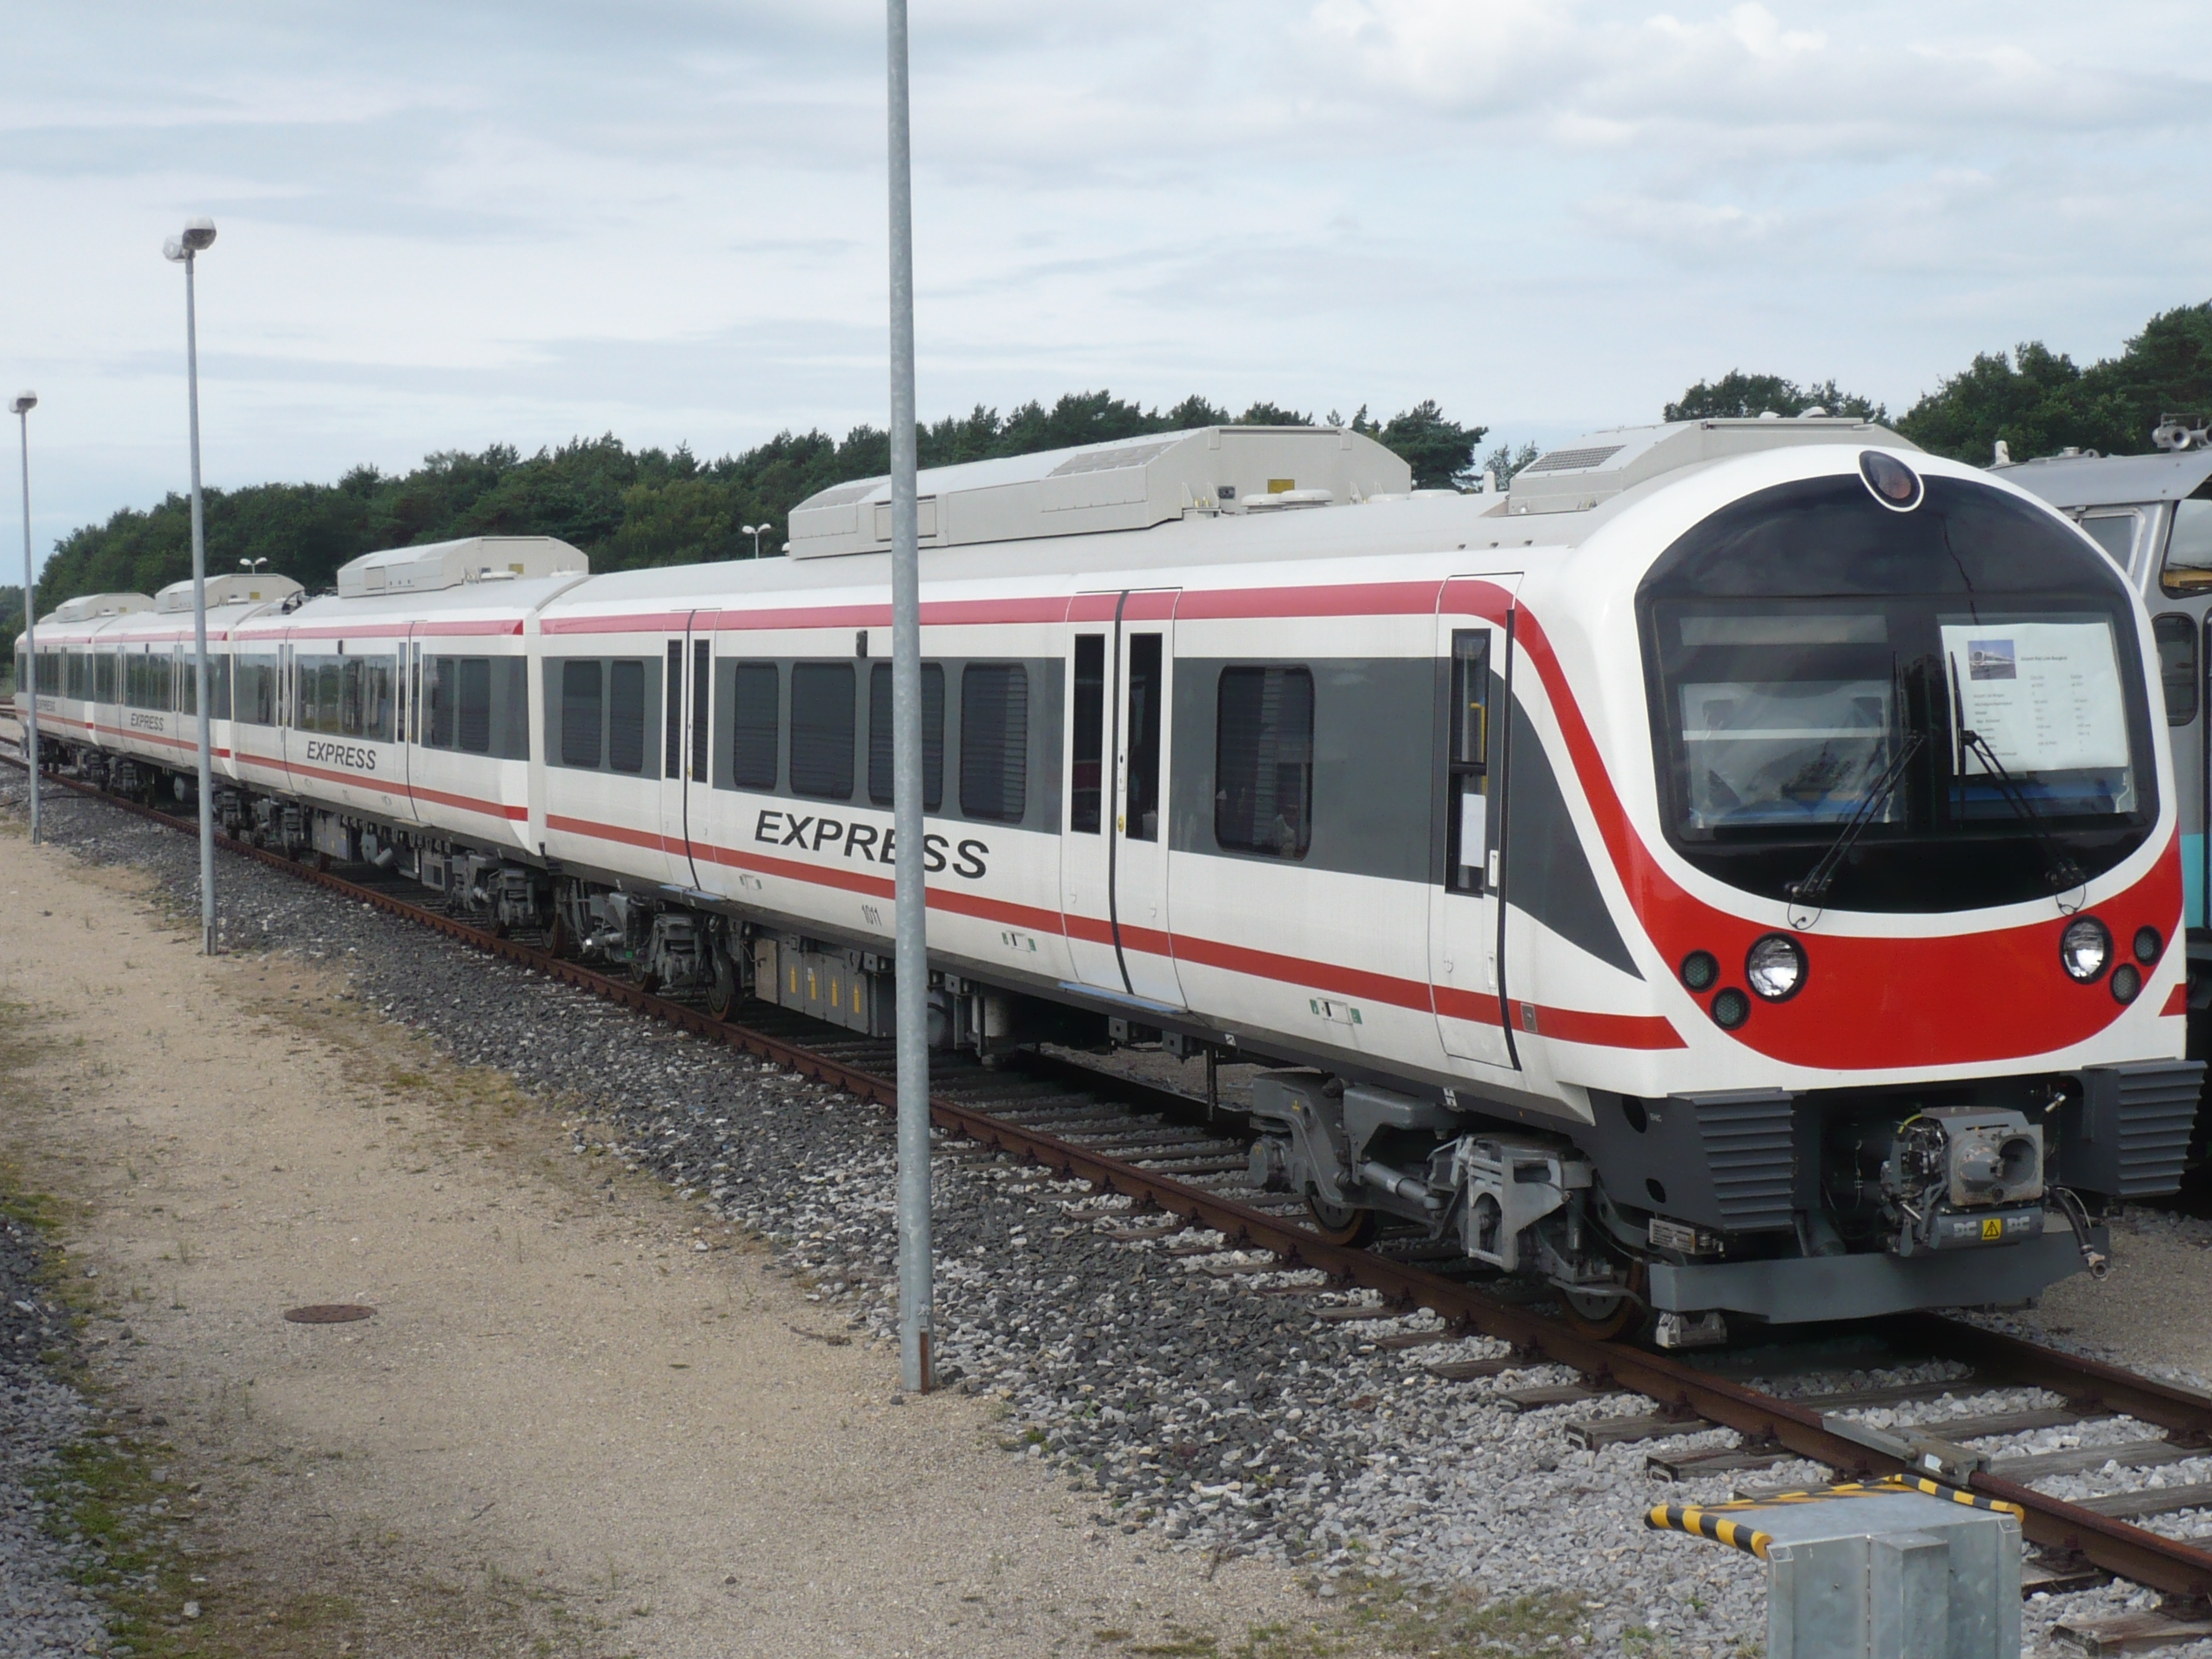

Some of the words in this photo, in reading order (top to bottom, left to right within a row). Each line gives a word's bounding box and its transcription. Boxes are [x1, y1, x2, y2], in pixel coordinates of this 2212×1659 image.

[131, 712, 164, 732] EXPRESS
[307, 740, 376, 771] EXPRESS
[754, 809, 990, 880] EXPRESS
[861, 904, 882, 927] 1011
